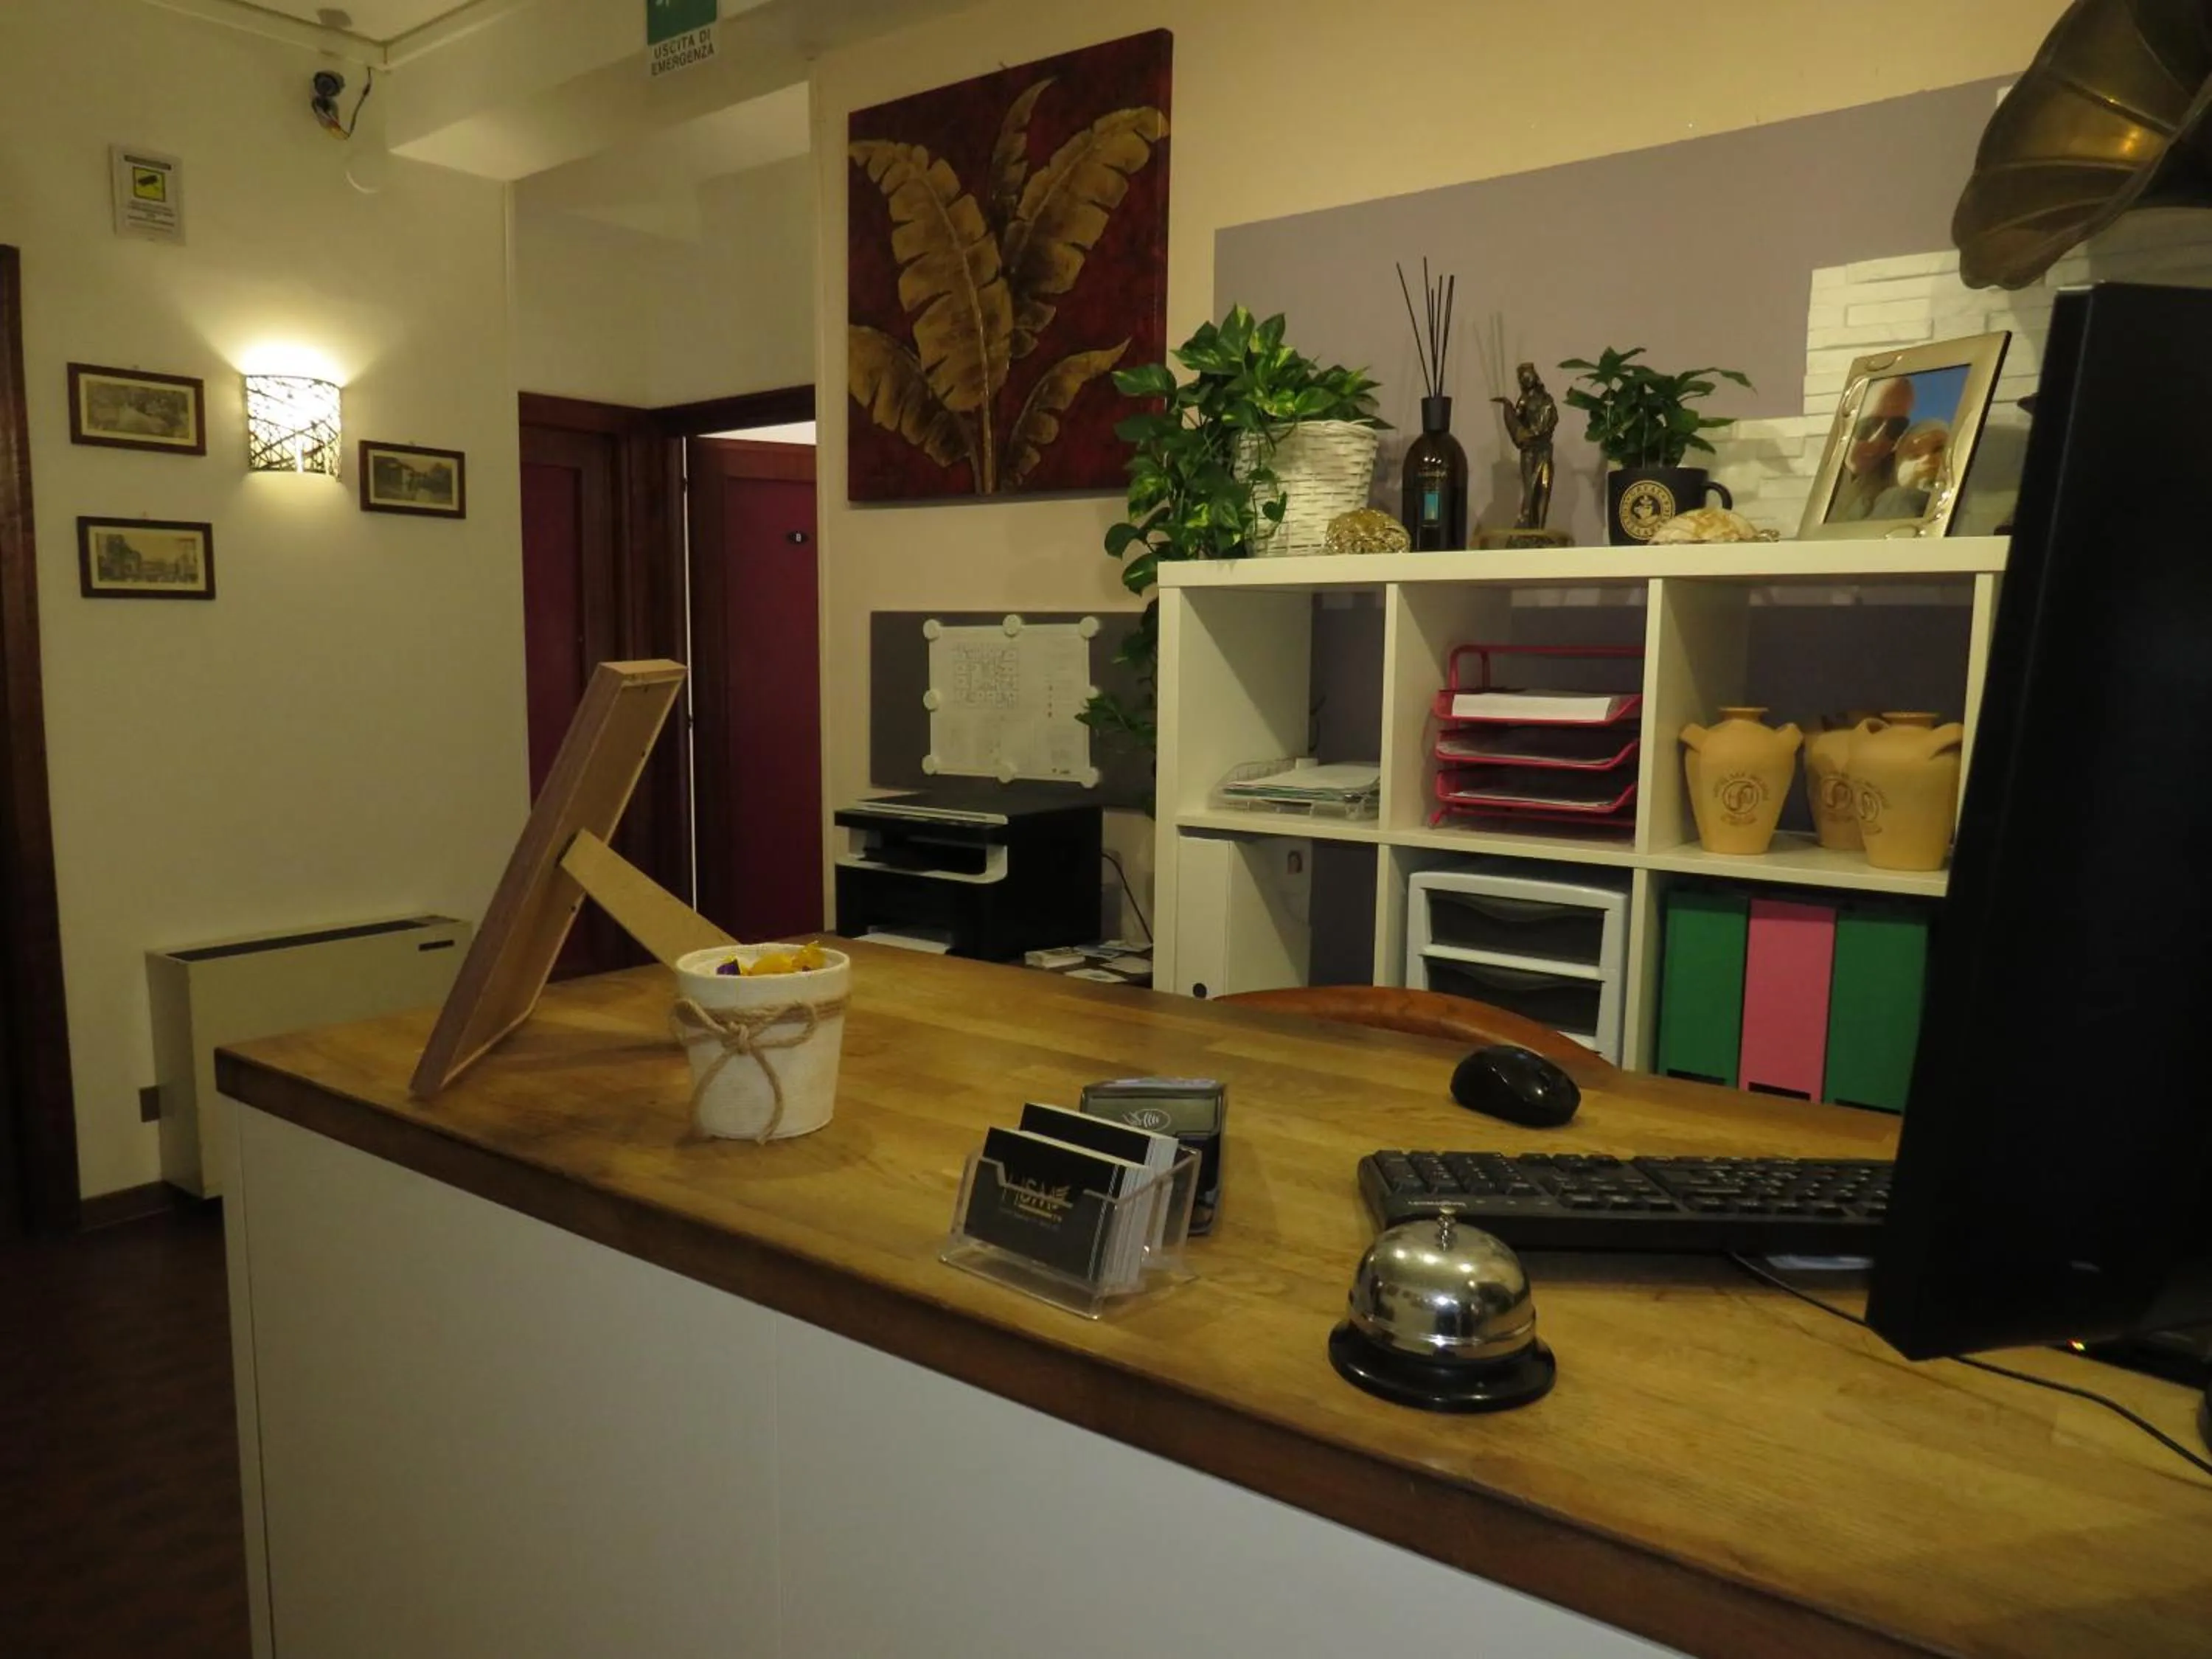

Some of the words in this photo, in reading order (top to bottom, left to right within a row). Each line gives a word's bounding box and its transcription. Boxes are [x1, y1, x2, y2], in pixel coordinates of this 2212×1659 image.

[651, 42, 714, 76] EMERGENZA
[653, 34, 695, 59] USCITA
[699, 28, 711, 44] DI
